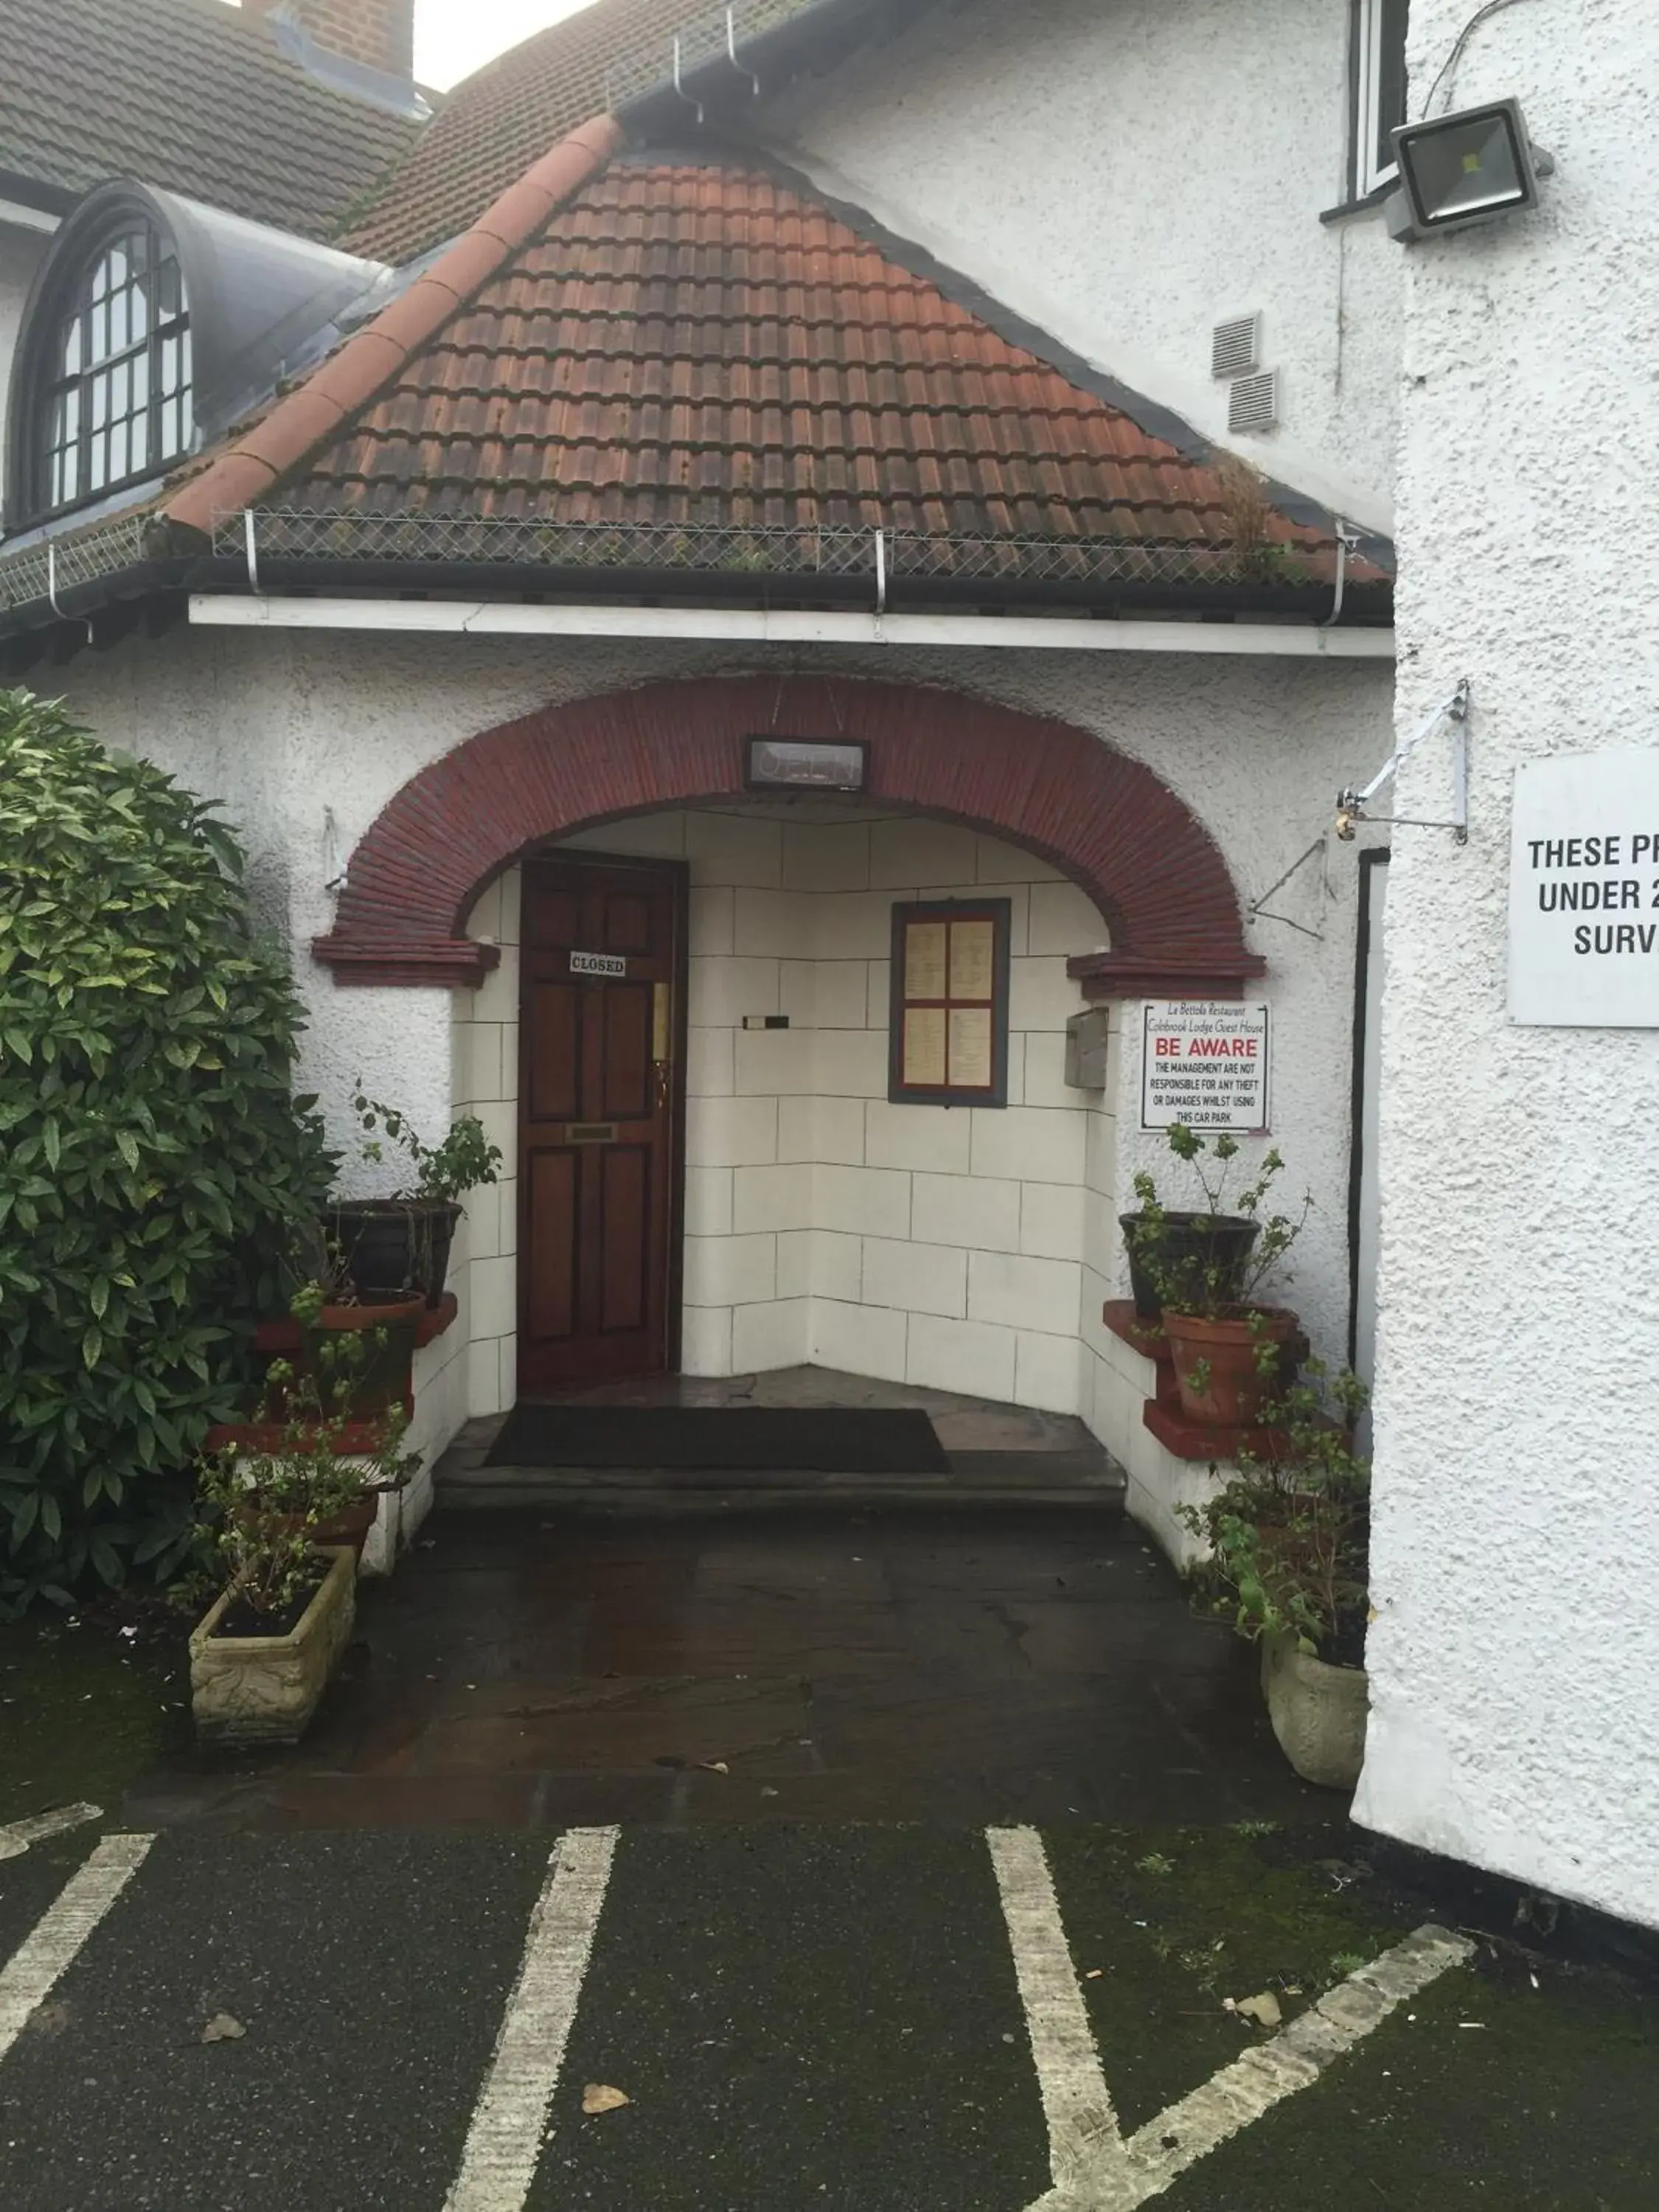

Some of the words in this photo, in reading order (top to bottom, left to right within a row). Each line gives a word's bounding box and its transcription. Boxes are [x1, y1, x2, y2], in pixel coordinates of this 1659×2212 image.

[1528, 835, 1621, 869] THESE
[1539, 880, 1641, 912] UNDER
[1574, 924, 1657, 955] SURV
[572, 956, 623, 972] CLOSED
[1209, 1003, 1245, 1016] Restaurant
[1189, 1020, 1213, 1034] Lodge
[1215, 1019, 1238, 1033] Guest
[1240, 1020, 1264, 1033] House
[1155, 1037, 1181, 1057] BE
[1188, 1039, 1258, 1057] AWARE
[1155, 1062, 1169, 1073] THE
[1171, 1062, 1222, 1074] MANAGEMENT
[1224, 1063, 1239, 1074] ARE
[1240, 1063, 1255, 1074] NOT
[1150, 1079, 1200, 1091] RESPONSIBLE
[1202, 1079, 1215, 1090] FOR
[1218, 1079, 1234, 1091] ANY
[1236, 1080, 1259, 1091] THEFT
[1153, 1095, 1164, 1106] OR
[1165, 1095, 1201, 1106] DAMAGES
[1202, 1096, 1231, 1107] WHILST
[1233, 1096, 1255, 1107] USING
[1177, 1111, 1192, 1122] THIS
[1194, 1112, 1210, 1123] CAR
[1211, 1112, 1232, 1124] PARK
